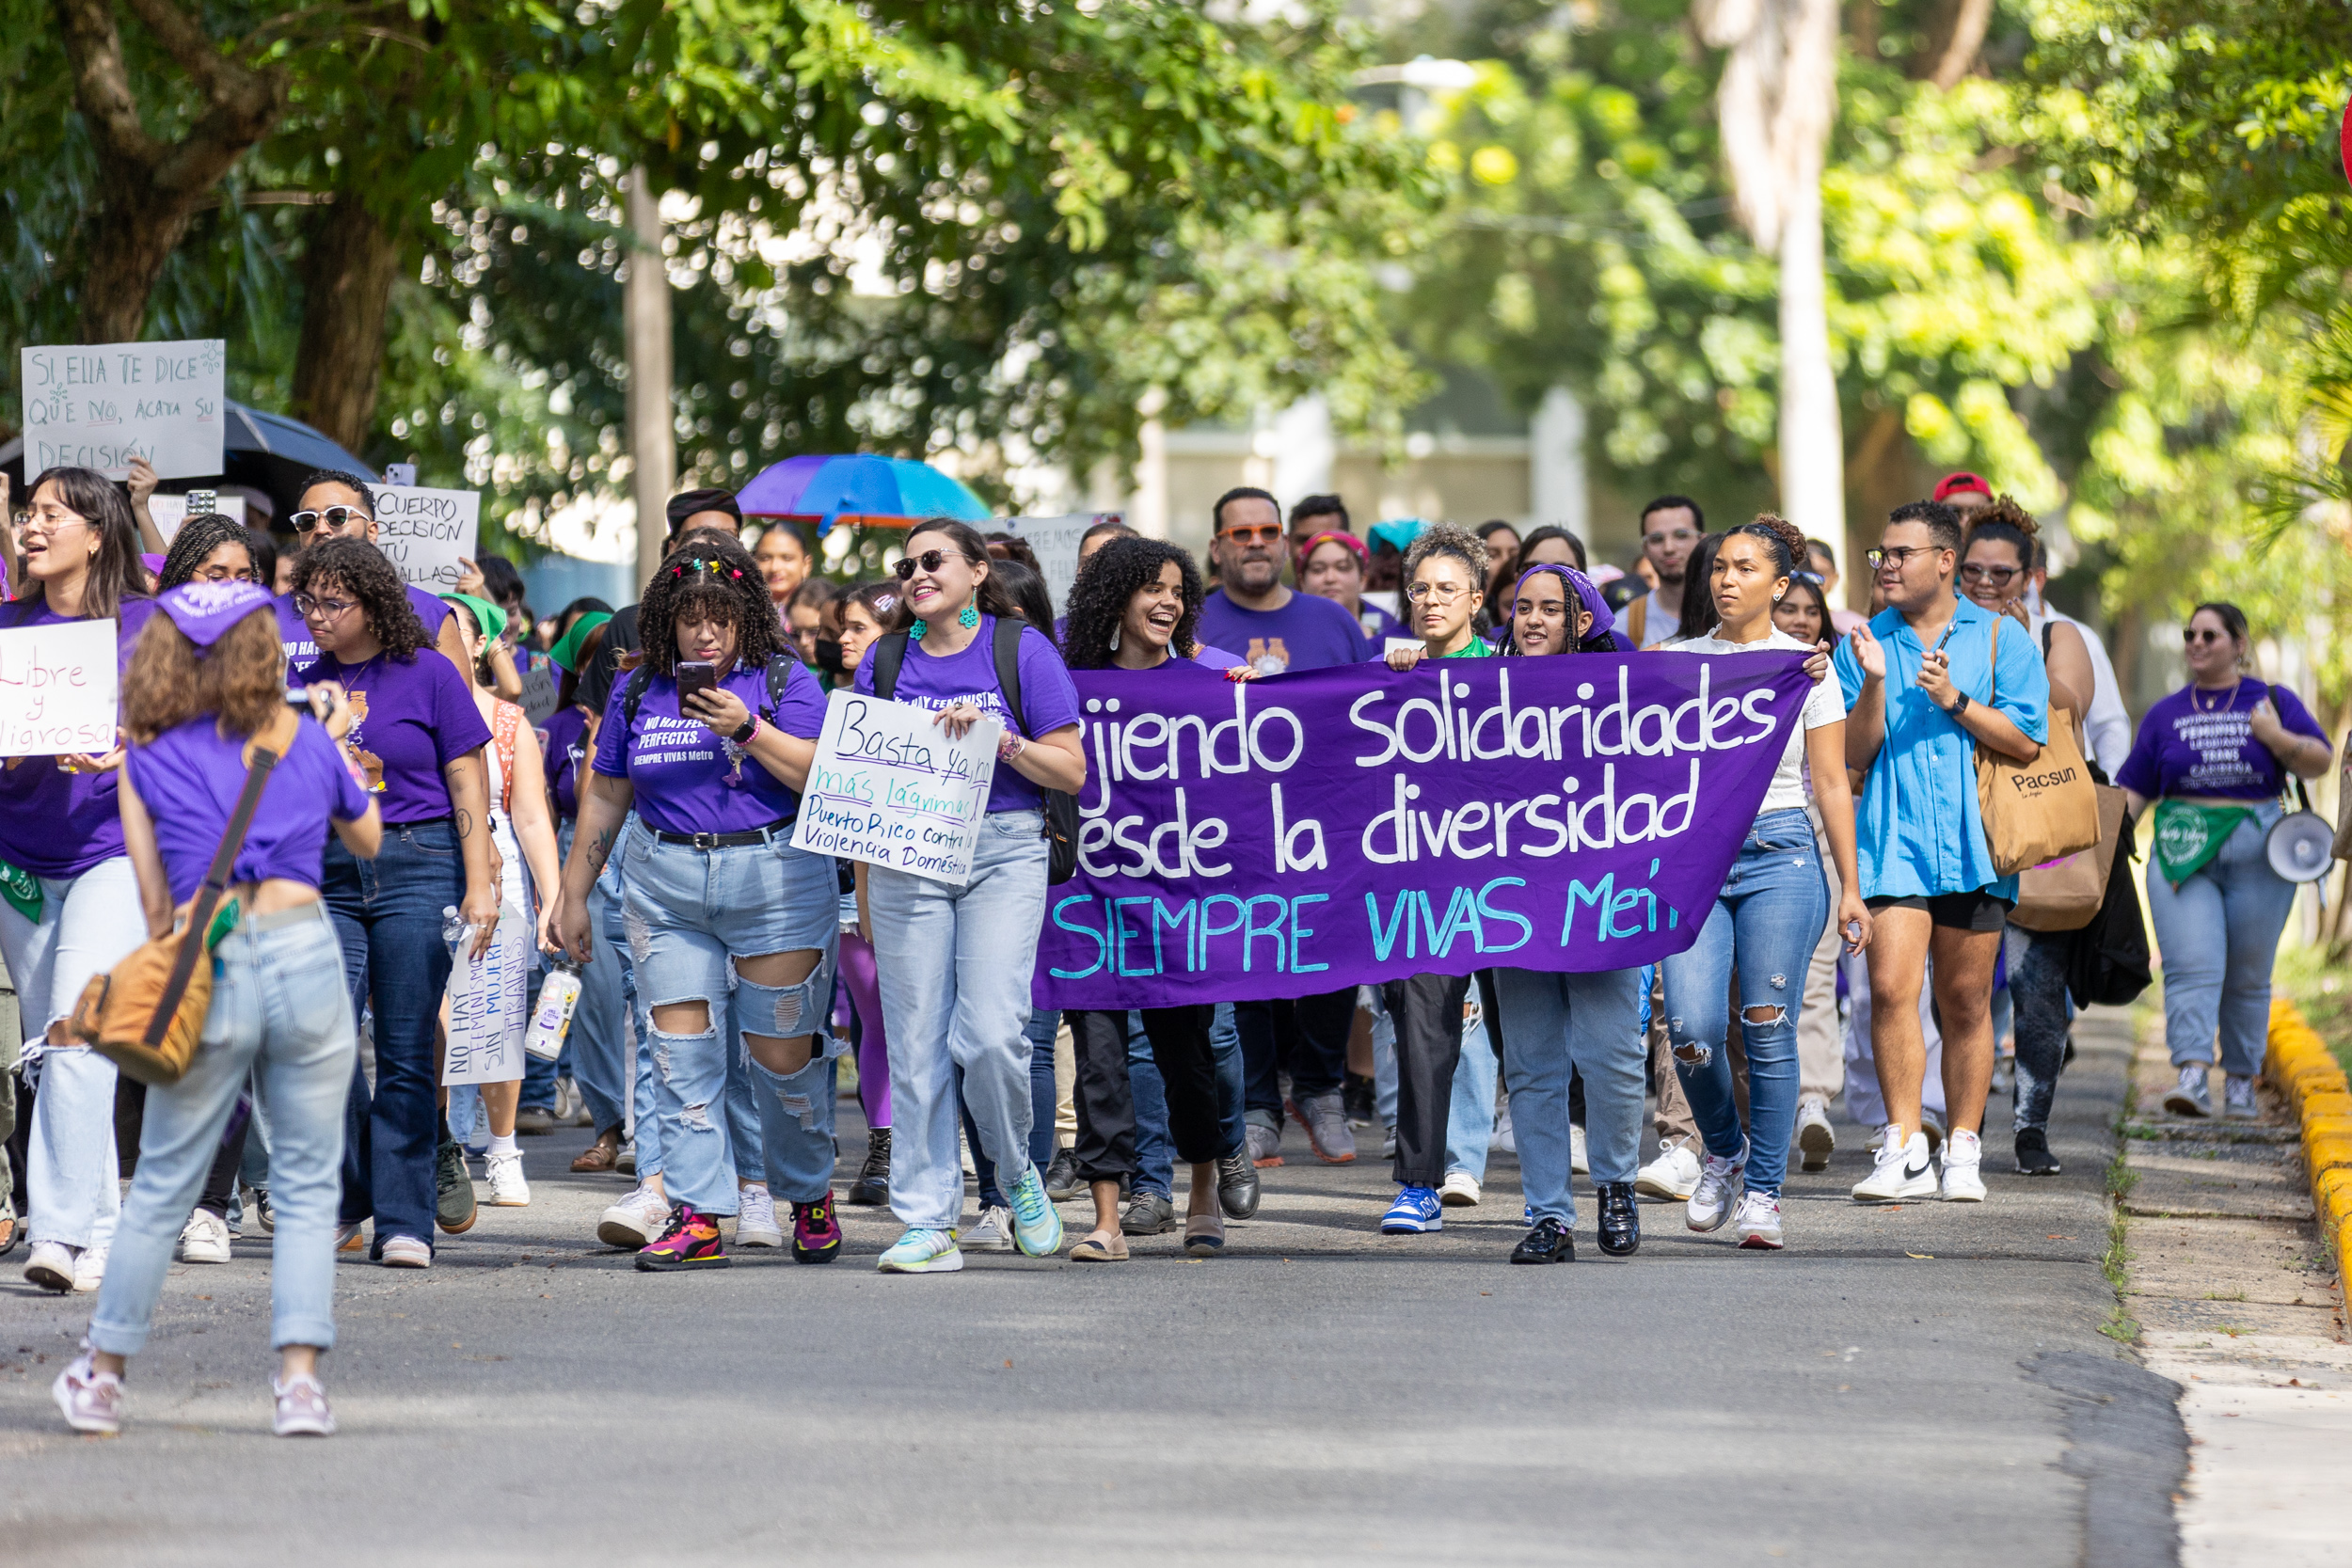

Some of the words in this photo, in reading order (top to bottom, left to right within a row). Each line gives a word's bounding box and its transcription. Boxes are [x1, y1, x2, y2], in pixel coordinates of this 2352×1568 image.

[31, 353, 55, 386] SI
[118, 354, 141, 385] TE
[155, 355, 197, 384] DICE
[28, 398, 76, 425] QUE
[195, 397, 214, 418] SU
[377, 492, 457, 522] CUERPO
[379, 539, 408, 562] TÚ
[398, 565, 461, 585] ALLAS
[0, 645, 87, 688] Libre
[0, 720, 110, 753] ligrosa
[638, 730, 701, 750] PERFECTXS.
[644, 716, 660, 731] NO
[659, 716, 683, 729] HAY
[836, 700, 935, 774] Basta
[633, 752, 662, 766] SIEMPRE
[663, 752, 687, 763] VIVAS
[688, 751, 714, 762] Metro
[1078, 683, 1303, 817] jiendo
[2201, 748, 2240, 764] TRANS
[815, 765, 874, 801] más
[2011, 767, 2076, 792] Pacsun
[806, 794, 864, 833] Puerto
[866, 813, 916, 840] Rico
[1075, 786, 1232, 879] esde
[1271, 782, 1327, 874] la
[1361, 758, 1700, 864] diversidad
[805, 824, 890, 863] Violencia
[902, 846, 966, 876] Doméstica
[1050, 893, 1329, 979] SIEMPRE
[1365, 876, 1533, 962] VIVAS
[503, 936, 526, 1040] TRANS
[452, 993, 469, 1033] HAY
[449, 1045, 470, 1074] NO
[485, 1031, 501, 1071] SIN
